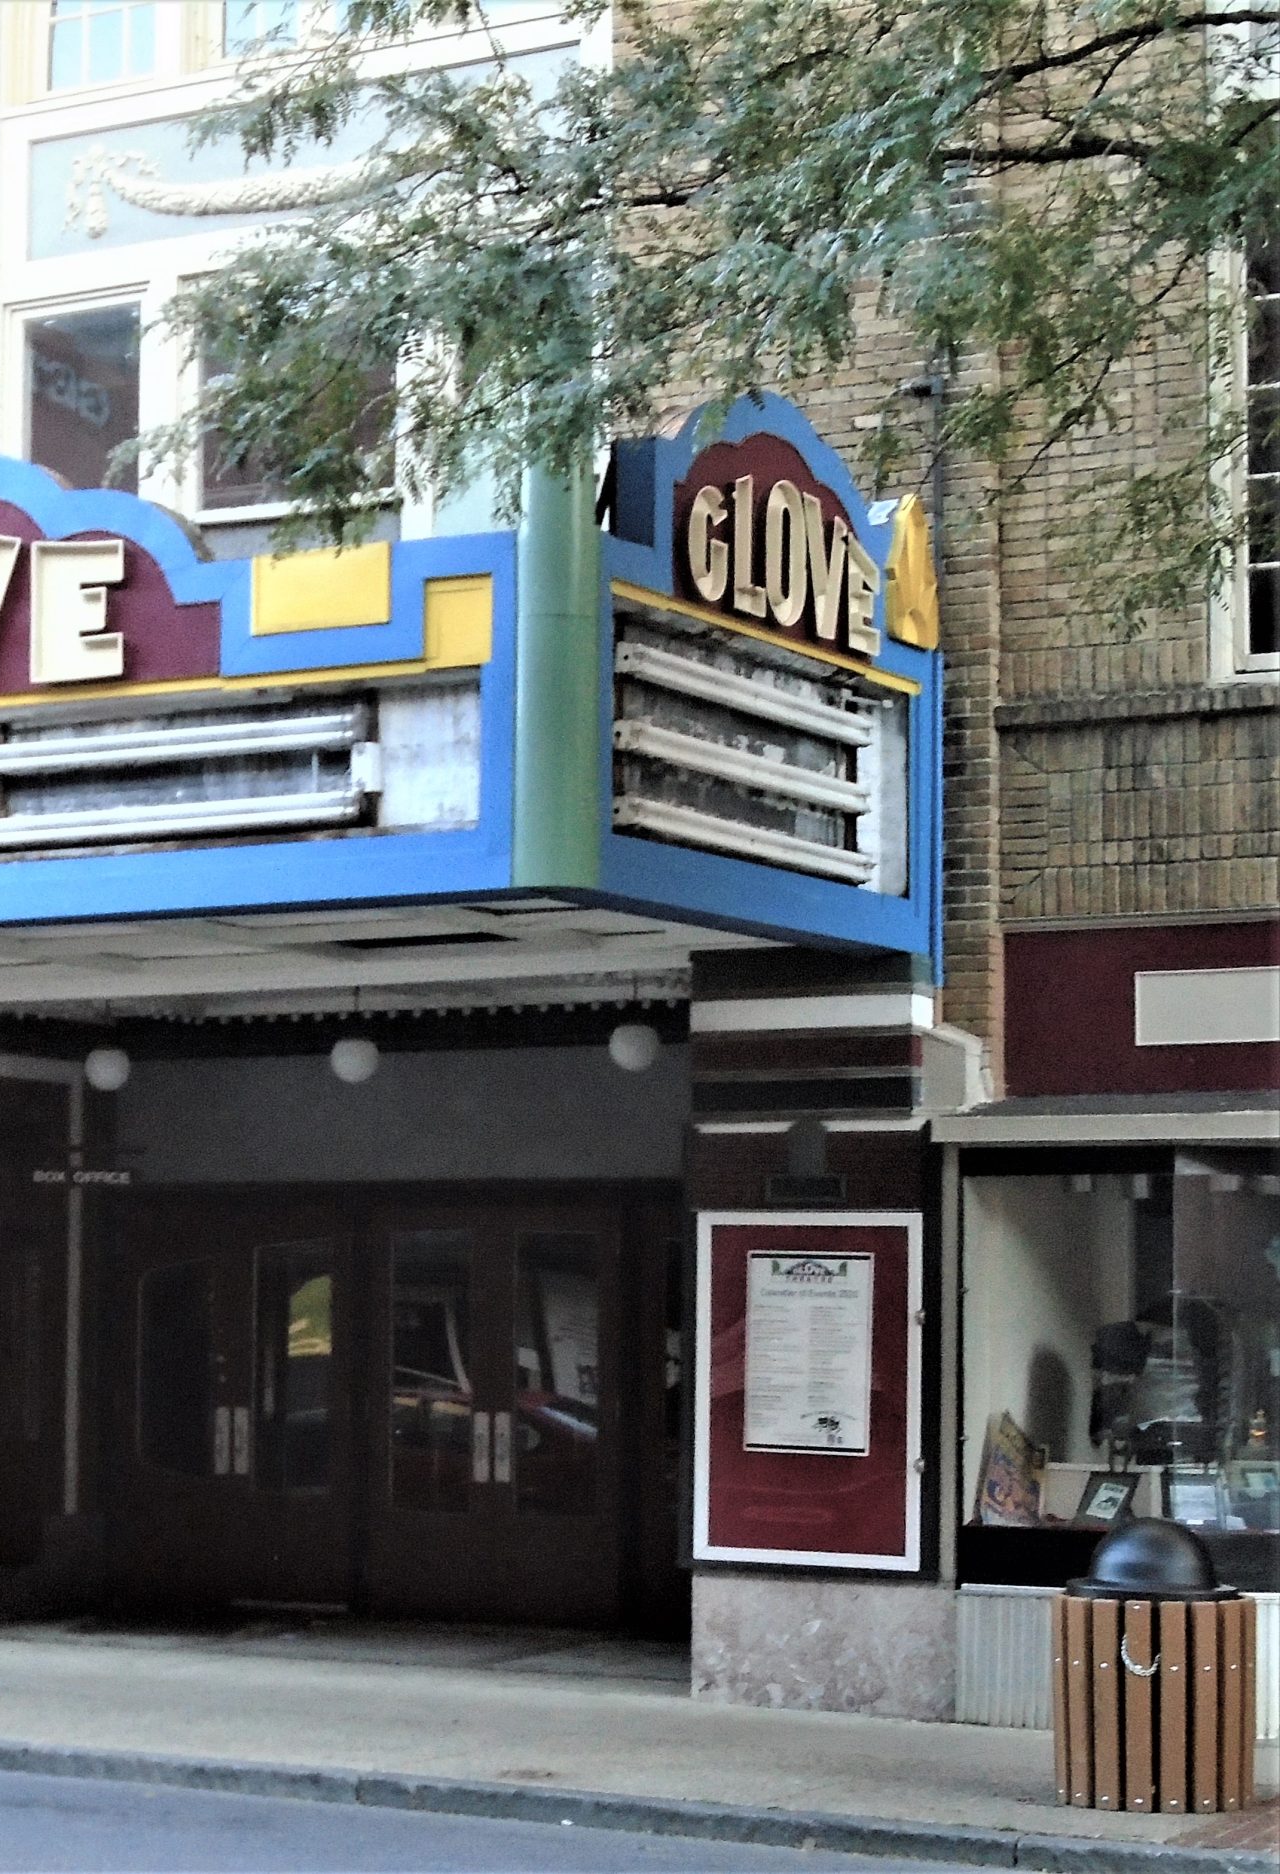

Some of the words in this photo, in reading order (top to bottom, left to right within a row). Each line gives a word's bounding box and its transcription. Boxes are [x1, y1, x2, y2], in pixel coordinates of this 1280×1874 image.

[688, 473, 880, 656] GLOVE
[33, 1170, 65, 1183] BOX
[73, 1171, 131, 1185] OFFICE
